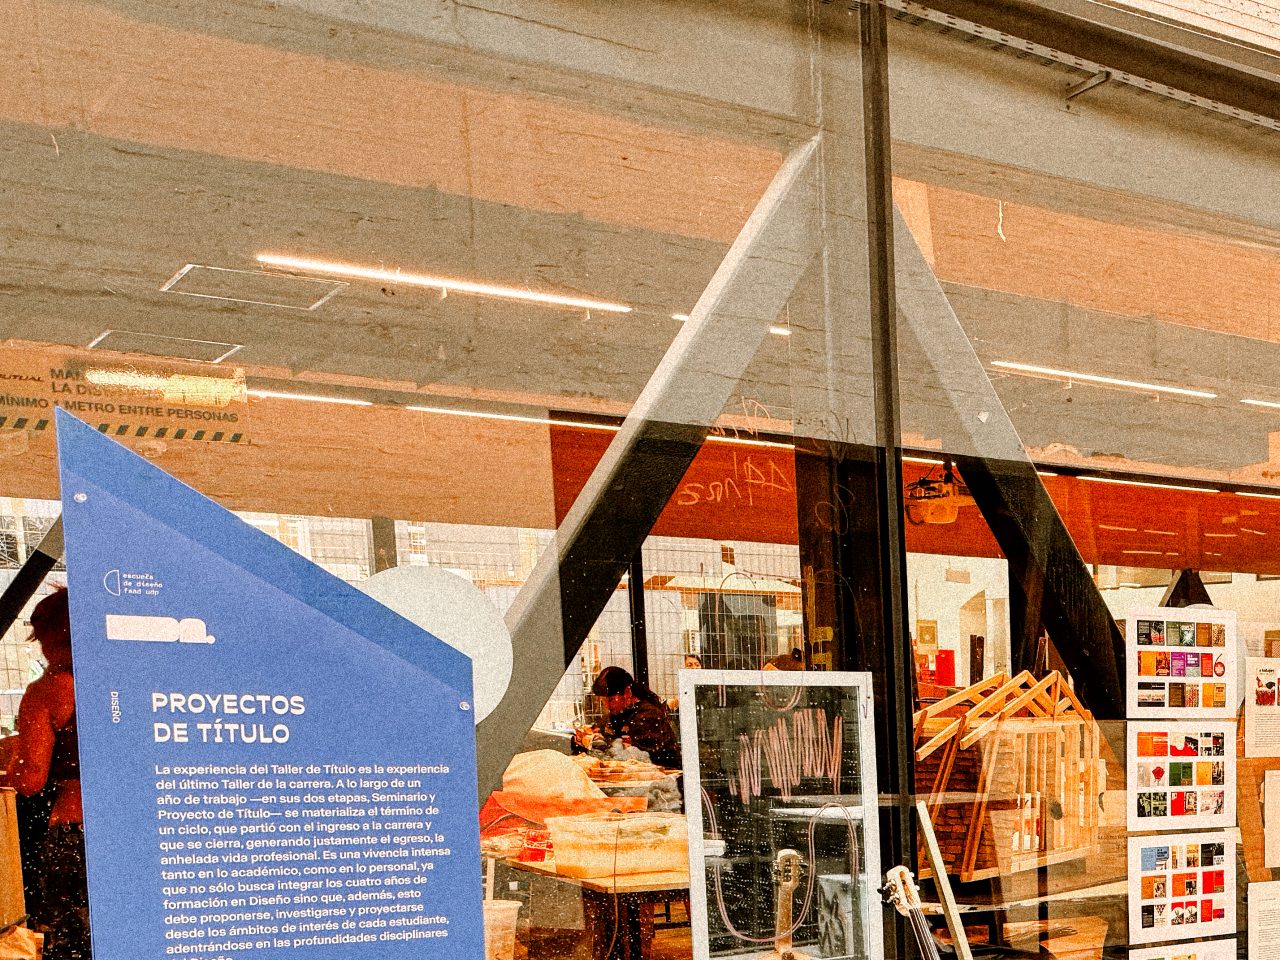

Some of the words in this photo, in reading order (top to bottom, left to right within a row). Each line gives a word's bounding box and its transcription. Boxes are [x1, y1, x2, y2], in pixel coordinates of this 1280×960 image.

[51, 382, 72, 394] LA
[64, 401, 115, 413] METRO
[119, 404, 164, 417] ENTRE
[167, 408, 239, 423] PERSONAS
[110, 691, 122, 723] DISEÑO
[151, 692, 305, 715] PROYECTOS
[153, 722, 189, 742] DE
[196, 718, 289, 743] TÍTULO
[155, 765, 170, 775] La
[173, 764, 247, 776] experiencia
[249, 764, 268, 774] del
[270, 764, 303, 774] Taller
[305, 764, 321, 774] de
[323, 764, 356, 774] Título
[358, 766, 372, 774] es
[374, 764, 384, 774] la
[386, 764, 449, 775] experiencia
[156, 779, 176, 790] del
[179, 779, 219, 790] último
[221, 779, 255, 789] Taller
[257, 779, 273, 789] de
[276, 779, 286, 789] la
[289, 781, 334, 789] carrera.
[336, 779, 345, 788] A
[346, 779, 357, 788] lo
[360, 778, 389, 790] largo
[390, 778, 405, 788] de
[407, 780, 421, 788] un
[157, 794, 181, 805] año
[184, 794, 200, 804] de
[203, 794, 247, 806] trabajo
[279, 795, 301, 803] sus
[303, 793, 325, 803] dos
[327, 794, 370, 804] etapas,
[371, 792, 428, 802] Seminario
[429, 794, 435, 803] y
[158, 810, 215, 822] Proyecto
[217, 809, 234, 819] de
[285, 810, 299, 818] se
[302, 807, 365, 817] materializa
[367, 806, 378, 816] el
[380, 806, 423, 816] término
[425, 805, 439, 815] de
[158, 827, 175, 835] un
[178, 824, 211, 835] ciclo,
[213, 825, 238, 836] que
[240, 822, 276, 835] partió
[278, 824, 301, 832] con
[303, 822, 314, 831] el
[317, 822, 360, 833] ingreso
[372, 821, 382, 830] la
[384, 822, 423, 830] carrera
[425, 822, 432, 830] y
[159, 841, 185, 852] que
[187, 841, 202, 849] se
[205, 838, 244, 849] cierra,
[245, 836, 311, 850] generando
[313, 835, 378, 848] justamente
[380, 834, 391, 844] el
[393, 835, 433, 845] egreso,
[435, 833, 444, 842] la
[160, 854, 219, 865] anhelada
[221, 853, 248, 863] vida
[251, 850, 320, 864] profesional.
[323, 850, 337, 860] Es
[339, 851, 361, 859] una
[362, 848, 409, 858] vivencia
[411, 847, 451, 857] intensa
[160, 870, 196, 880] tanto
[198, 870, 214, 879] en
[217, 868, 228, 878] lo
[231, 866, 301, 877] académico,
[303, 866, 337, 874] como
[339, 865, 354, 873] en
[356, 863, 367, 873] lo
[369, 861, 420, 874] personal,
[421, 862, 434, 872] ya
[162, 886, 187, 897] que
[190, 885, 206, 894] no
[208, 882, 235, 893] sólo
[237, 882, 275, 891] busca
[277, 880, 323, 891] integrar
[326, 878, 343, 888] los
[345, 877, 382, 887] cuatro
[384, 876, 411, 885] años
[413, 875, 427, 884] de
[163, 897, 228, 910] formación
[230, 898, 246, 907] en
[249, 895, 291, 906] Diseño
[293, 893, 318, 903] sino
[320, 894, 346, 904] que,
[347, 889, 396, 901] además,
[397, 890, 421, 898] esto
[164, 914, 197, 925] debe
[200, 912, 274, 925] proponerse,
[276, 907, 347, 919] investigarse
[348, 907, 356, 917] y
[358, 904, 424, 916] proyectarse
[165, 928, 205, 939] desde
[208, 927, 226, 937] los
[229, 924, 279, 936] ámbitos
[281, 923, 297, 933] de
[299, 920, 339, 932] interés
[341, 920, 356, 929] de
[358, 918, 387, 928] cada
[389, 915, 449, 927] estudiante,
[166, 940, 253, 954] adentrándose
[255, 941, 271, 949] en
[273, 938, 291, 947] las
[293, 933, 377, 948] profundidades
[379, 929, 448, 941] disciplinares
